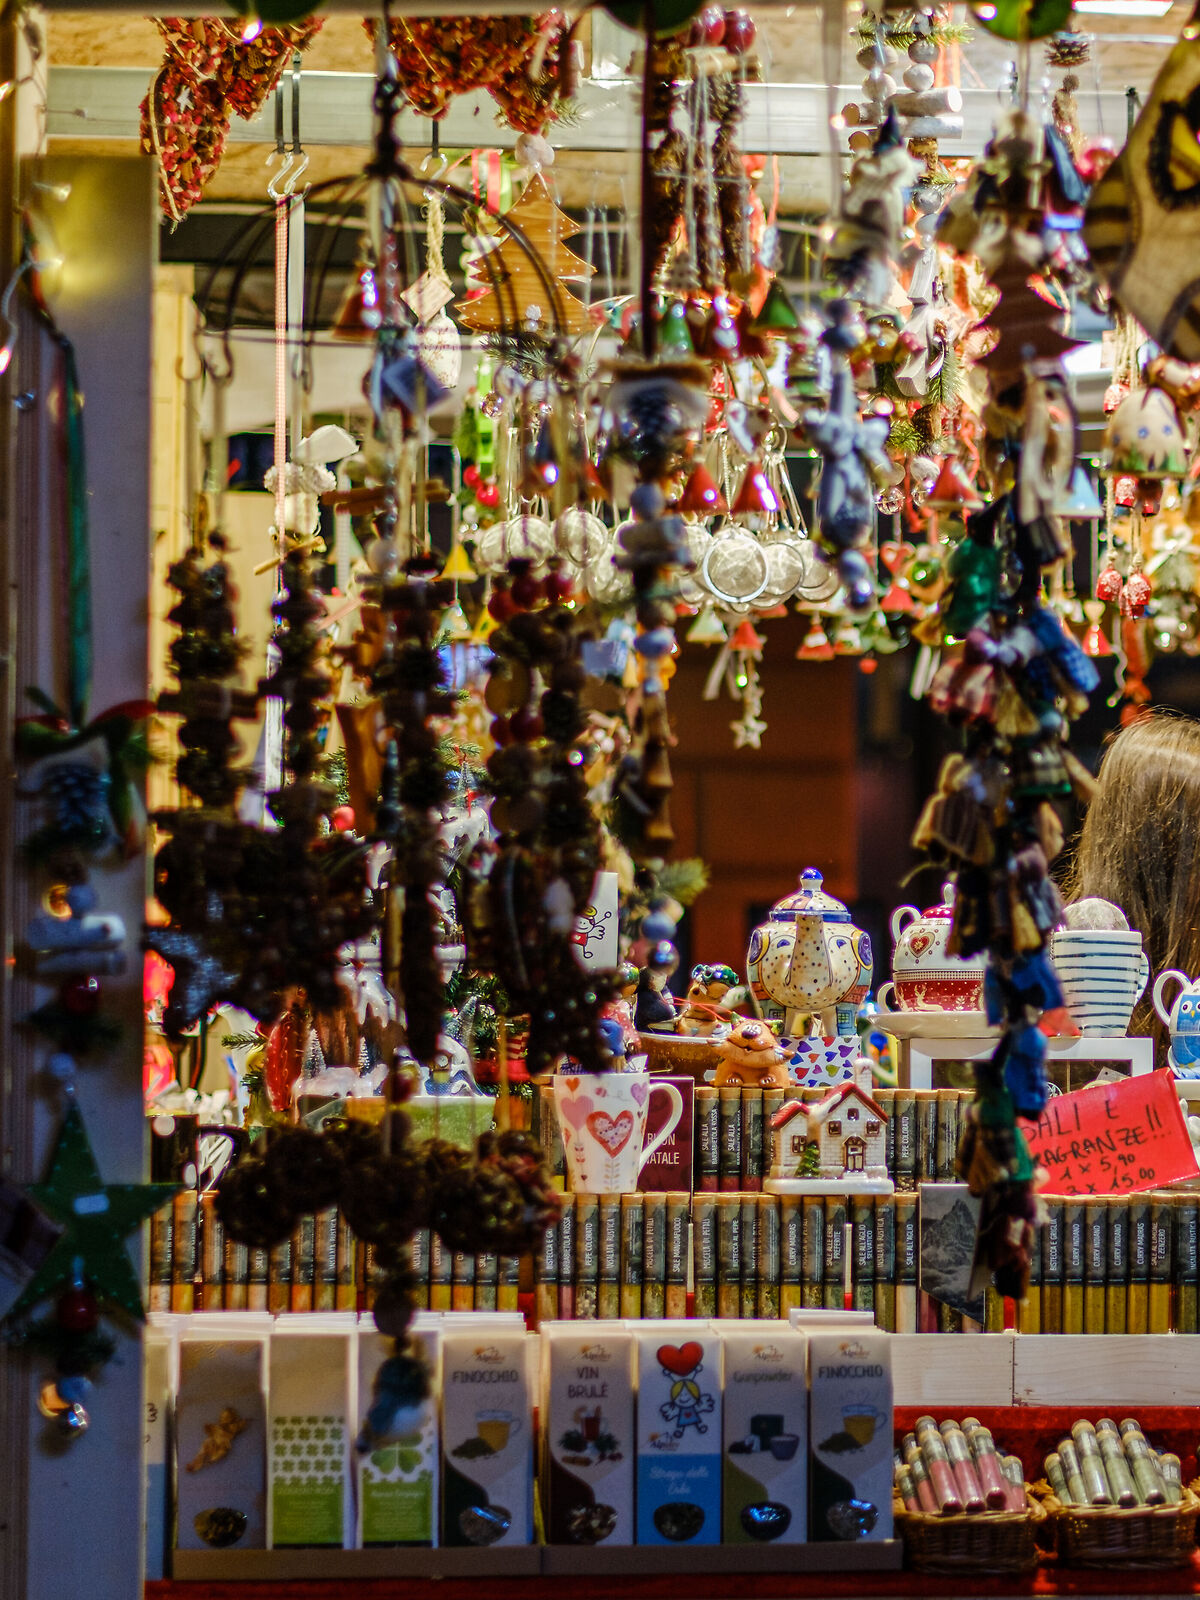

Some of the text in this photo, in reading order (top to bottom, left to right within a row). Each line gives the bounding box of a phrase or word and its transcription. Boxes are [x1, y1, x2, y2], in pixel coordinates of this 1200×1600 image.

[1105, 1100, 1120, 1119] E
[647, 1132, 676, 1146] BN
[701, 1123, 709, 1150] SALE ALLA
[646, 1152, 680, 1165] ATALE
[703, 1218, 711, 1236] PETALI
[1049, 1218, 1057, 1240] GRIGLIA
[1189, 1220, 1197, 1243] RUSTICA
[606, 1218, 614, 1269] INSALATA RUSTICA
[673, 1217, 681, 1272] SALE MANGIAFUOCO
[1072, 1223, 1080, 1266] CURRY INDIANO
[1093, 1225, 1101, 1267] CURRY INDIANO
[1114, 1223, 1122, 1266] CURRY INDIANO
[545, 1243, 553, 1270] BISTECCA
[703, 1245, 711, 1269] MISCELA
[1049, 1246, 1057, 1271] BISTECCA
[1189, 1245, 1197, 1270] INSALATA
[452, 1369, 519, 1384] FINOCCHIO
[577, 1366, 599, 1379] VIN
[818, 1364, 883, 1379] FINOCCHIO
